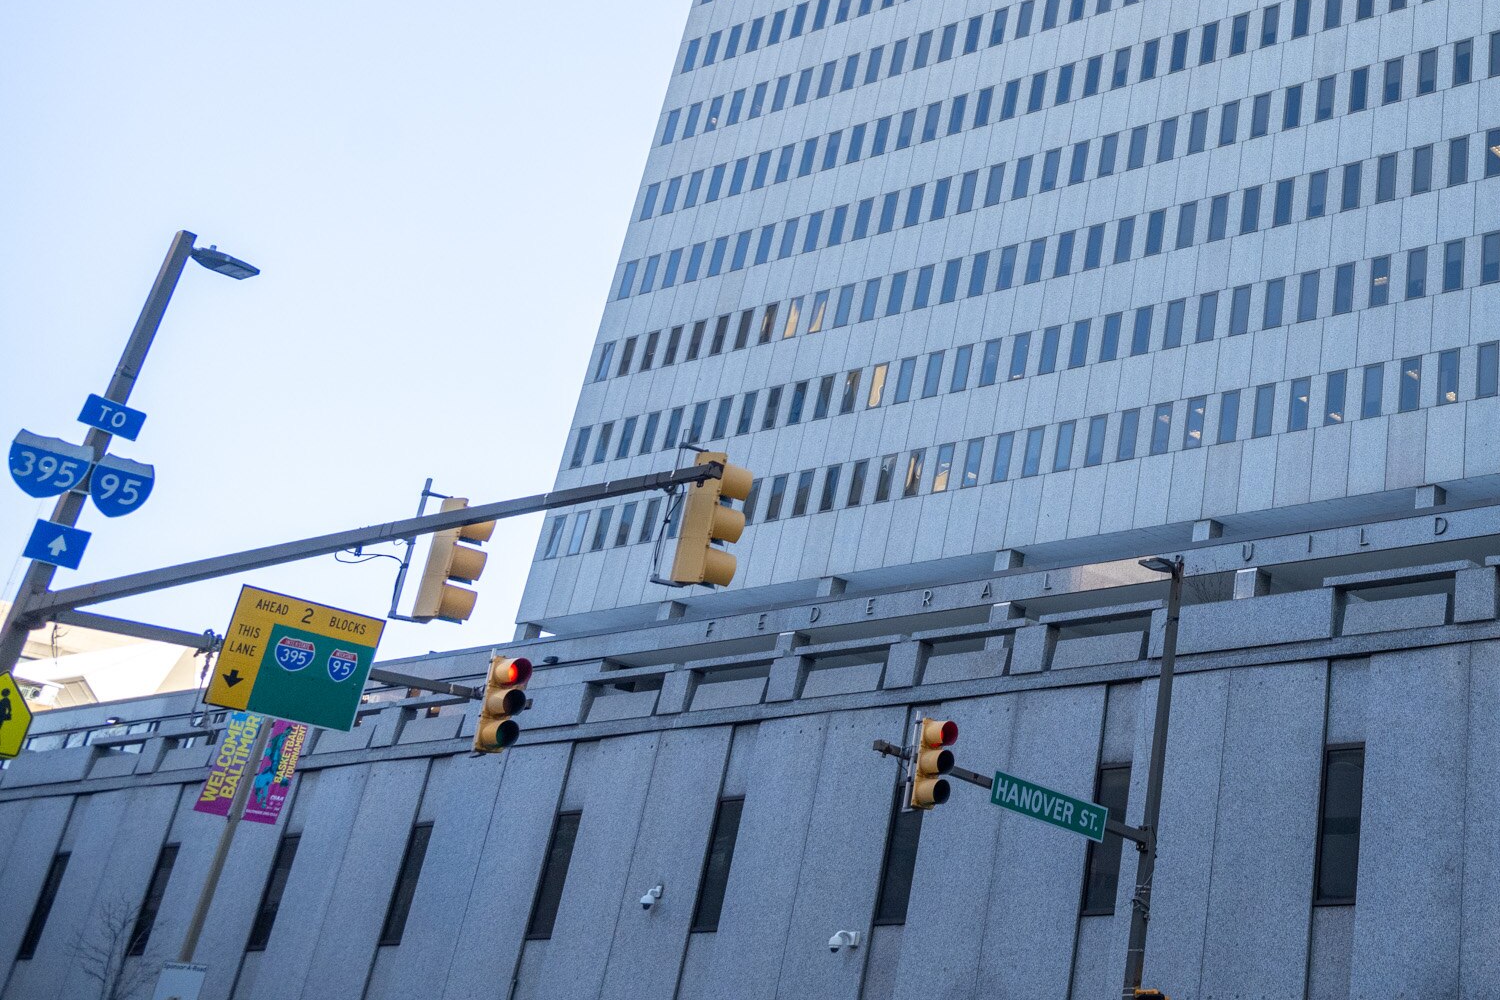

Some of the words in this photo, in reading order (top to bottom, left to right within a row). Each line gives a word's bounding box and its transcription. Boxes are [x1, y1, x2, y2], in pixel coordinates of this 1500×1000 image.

[99, 405, 127, 428] TO
[12, 451, 78, 488] 395
[100, 473, 142, 505] 95
[238, 623, 262, 639] THIS
[255, 598, 289, 616] AHEAD
[301, 607, 315, 625] 2
[329, 616, 367, 635] BLOCKS
[705, 573, 1052, 638] FEDERAL
[229, 640, 258, 657] LANE
[280, 648, 307, 665] 395
[332, 660, 351, 676] 95
[200, 718, 244, 802] WELCOME
[219, 714, 261, 799] BALTIMOR
[274, 723, 300, 783] BASKETBALL
[285, 724, 308, 778] TOURNAMENT
[995, 777, 1075, 825] HANOVER
[1078, 809, 1098, 832] ST.
